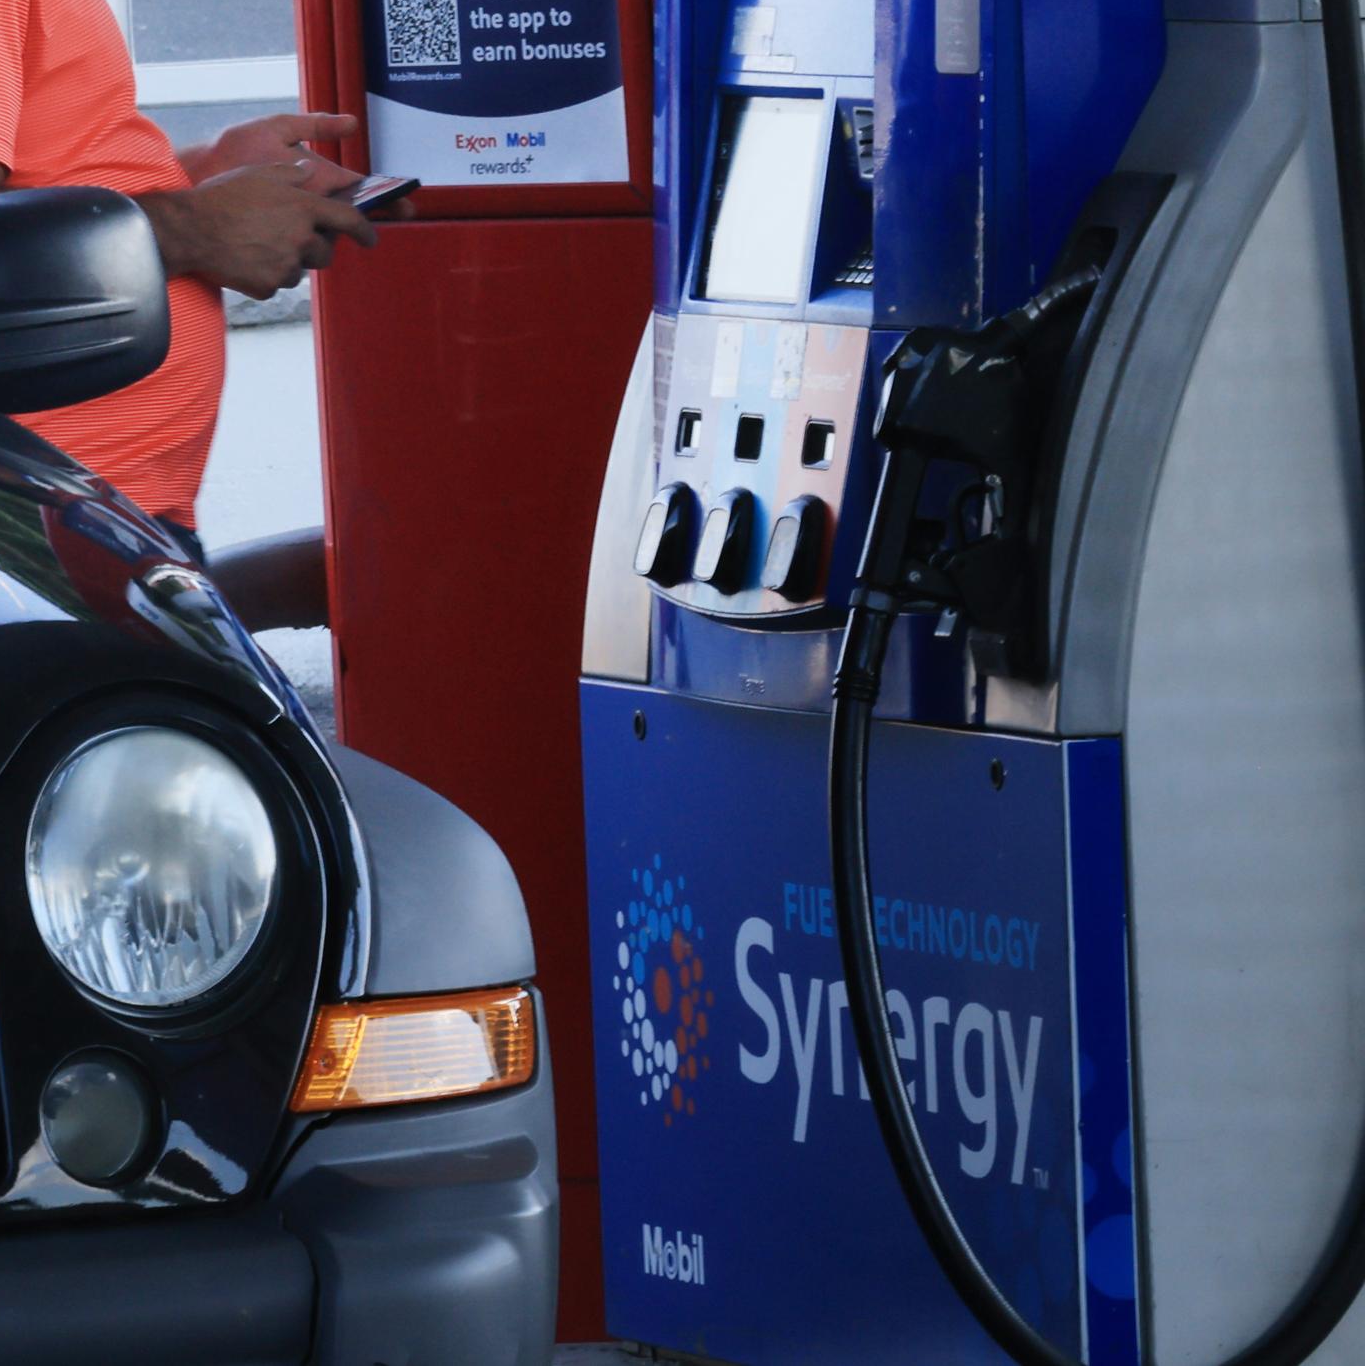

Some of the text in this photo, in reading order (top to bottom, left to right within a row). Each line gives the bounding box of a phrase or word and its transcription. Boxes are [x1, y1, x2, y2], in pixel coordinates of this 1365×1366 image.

[469, 7, 572, 34] the app to
[472, 38, 607, 63] earn bonuses
[455, 131, 546, 153] Exxon Mobil
[784, 883, 1041, 972] FUE ECHNOLOGY
[642, 1223, 705, 1287] Mobil
